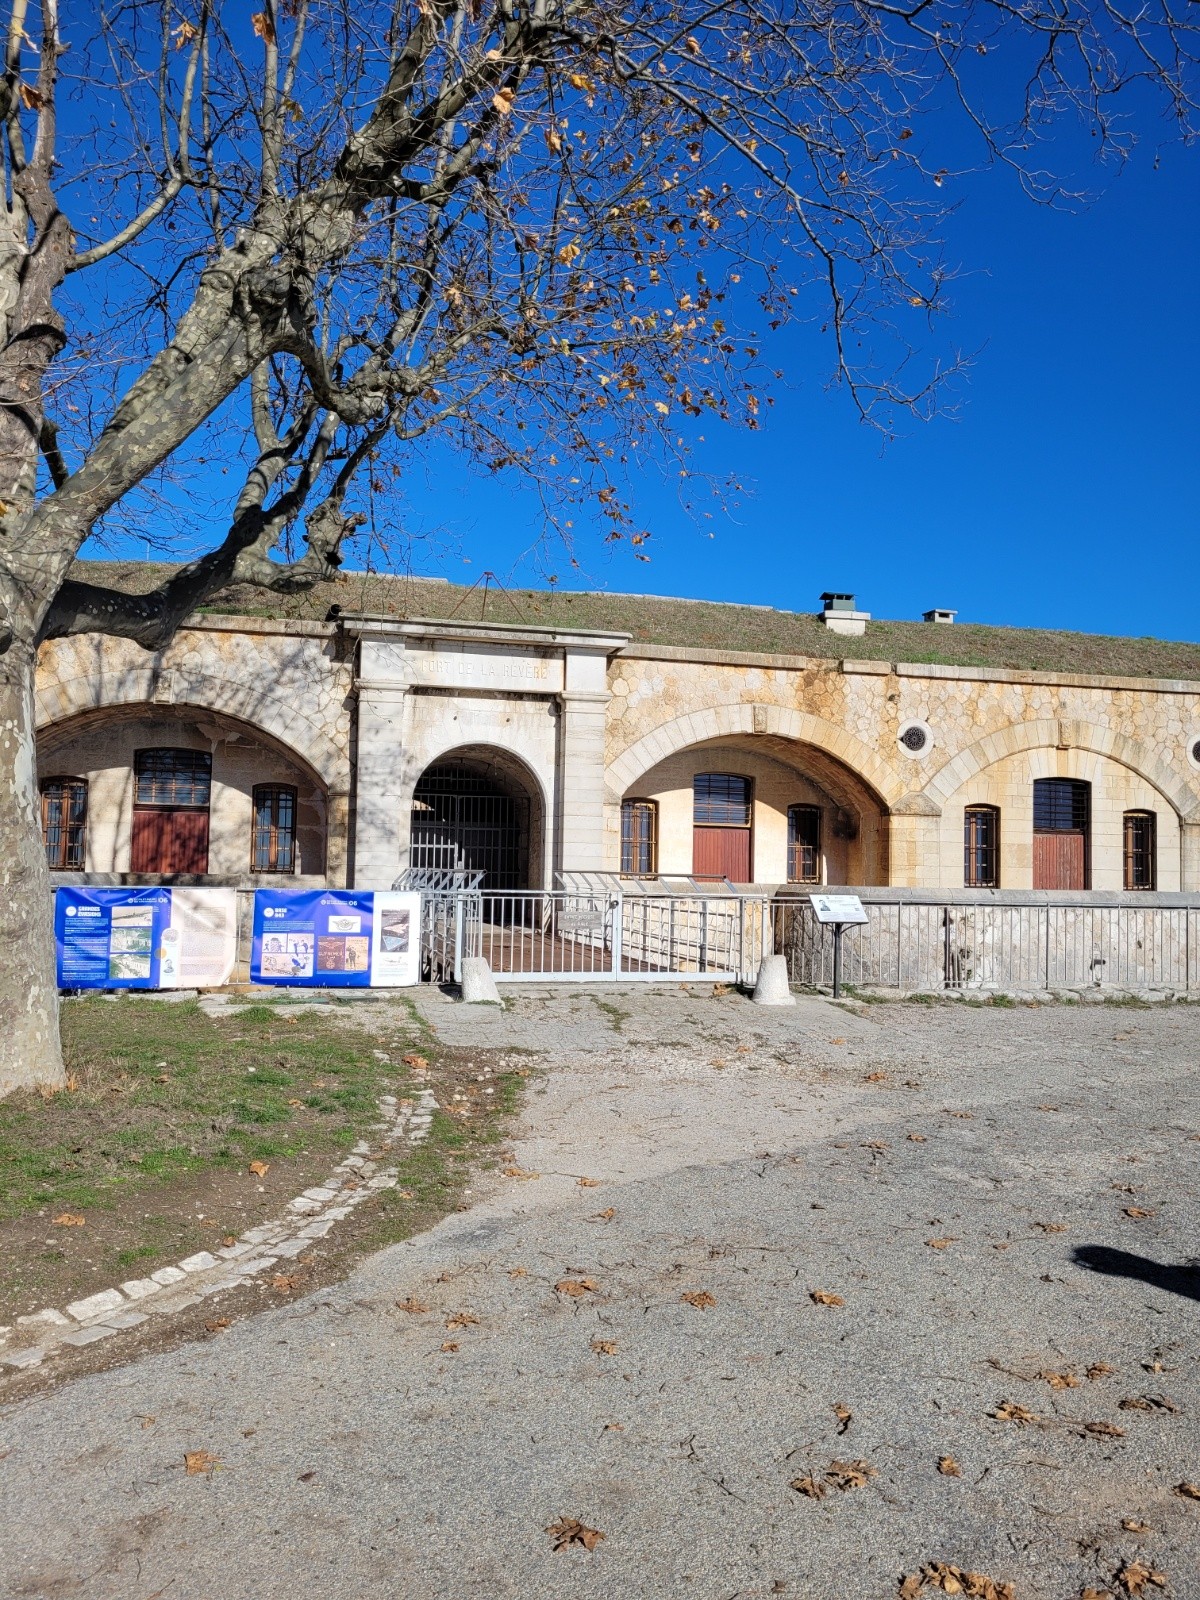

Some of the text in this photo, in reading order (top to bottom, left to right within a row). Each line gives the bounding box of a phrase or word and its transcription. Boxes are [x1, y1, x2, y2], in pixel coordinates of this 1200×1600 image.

[421, 660, 451, 674] FORT
[458, 662, 475, 675] DE
[481, 664, 498, 677] LA
